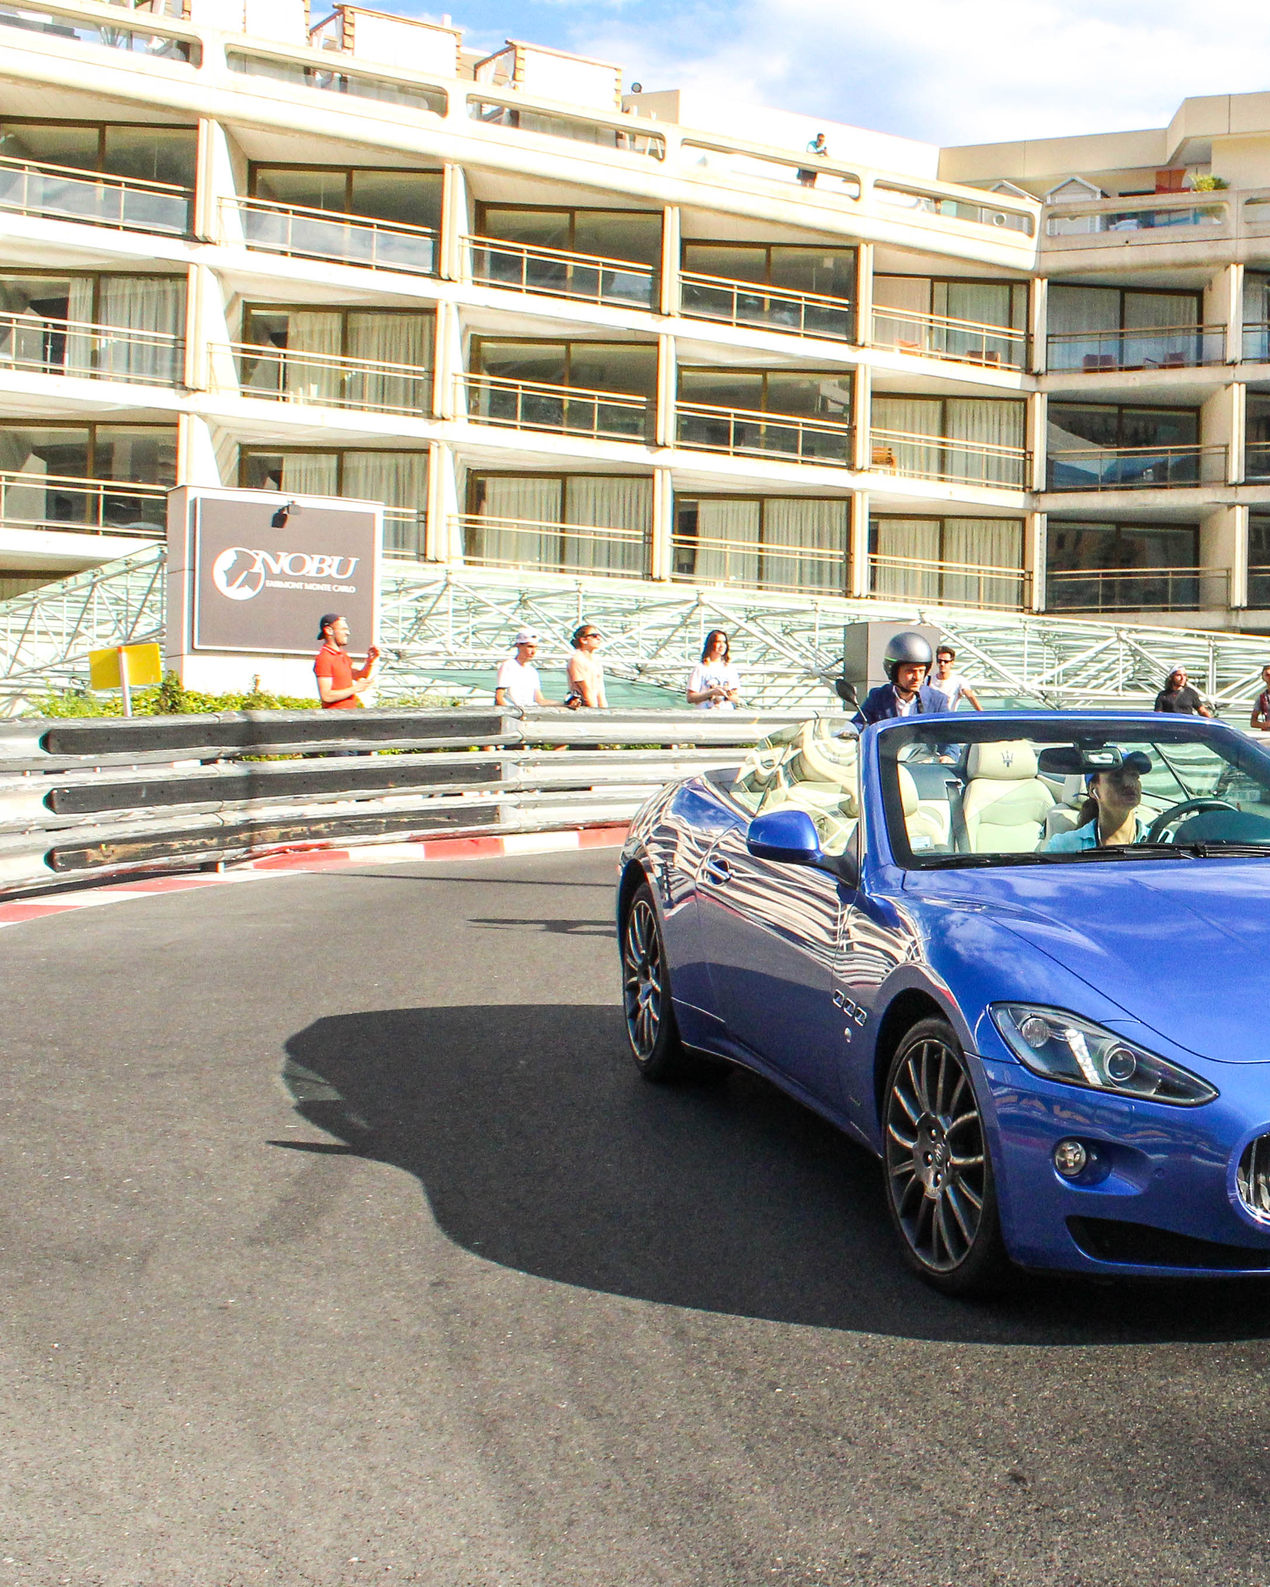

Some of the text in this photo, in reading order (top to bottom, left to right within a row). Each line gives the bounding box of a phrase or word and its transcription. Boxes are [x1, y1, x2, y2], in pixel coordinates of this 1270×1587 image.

[250, 549, 360, 580] NOBU
[265, 579, 357, 594] FAIRMONT MONTE CARLO
